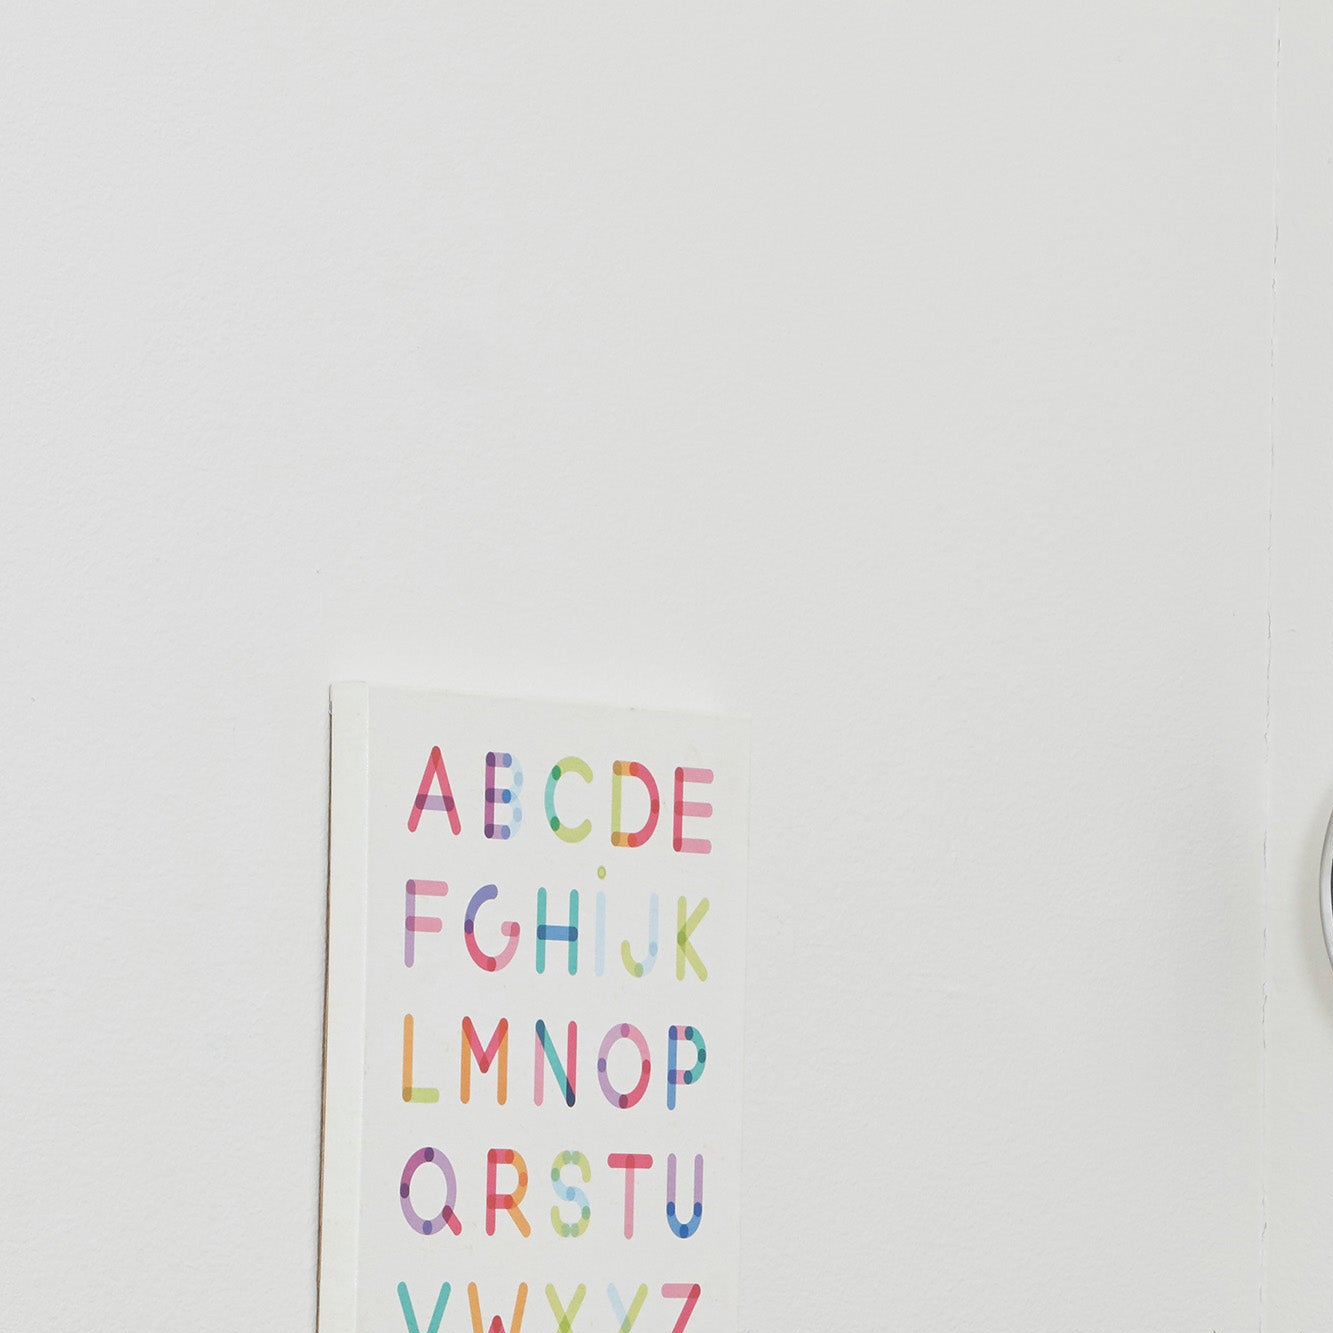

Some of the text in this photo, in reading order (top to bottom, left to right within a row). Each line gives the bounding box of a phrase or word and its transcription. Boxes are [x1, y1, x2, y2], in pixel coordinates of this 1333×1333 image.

[407, 745, 714, 854] ABCDE
[402, 1013, 707, 1110] LMNOP
[399, 1146, 704, 1240] QRSTU
